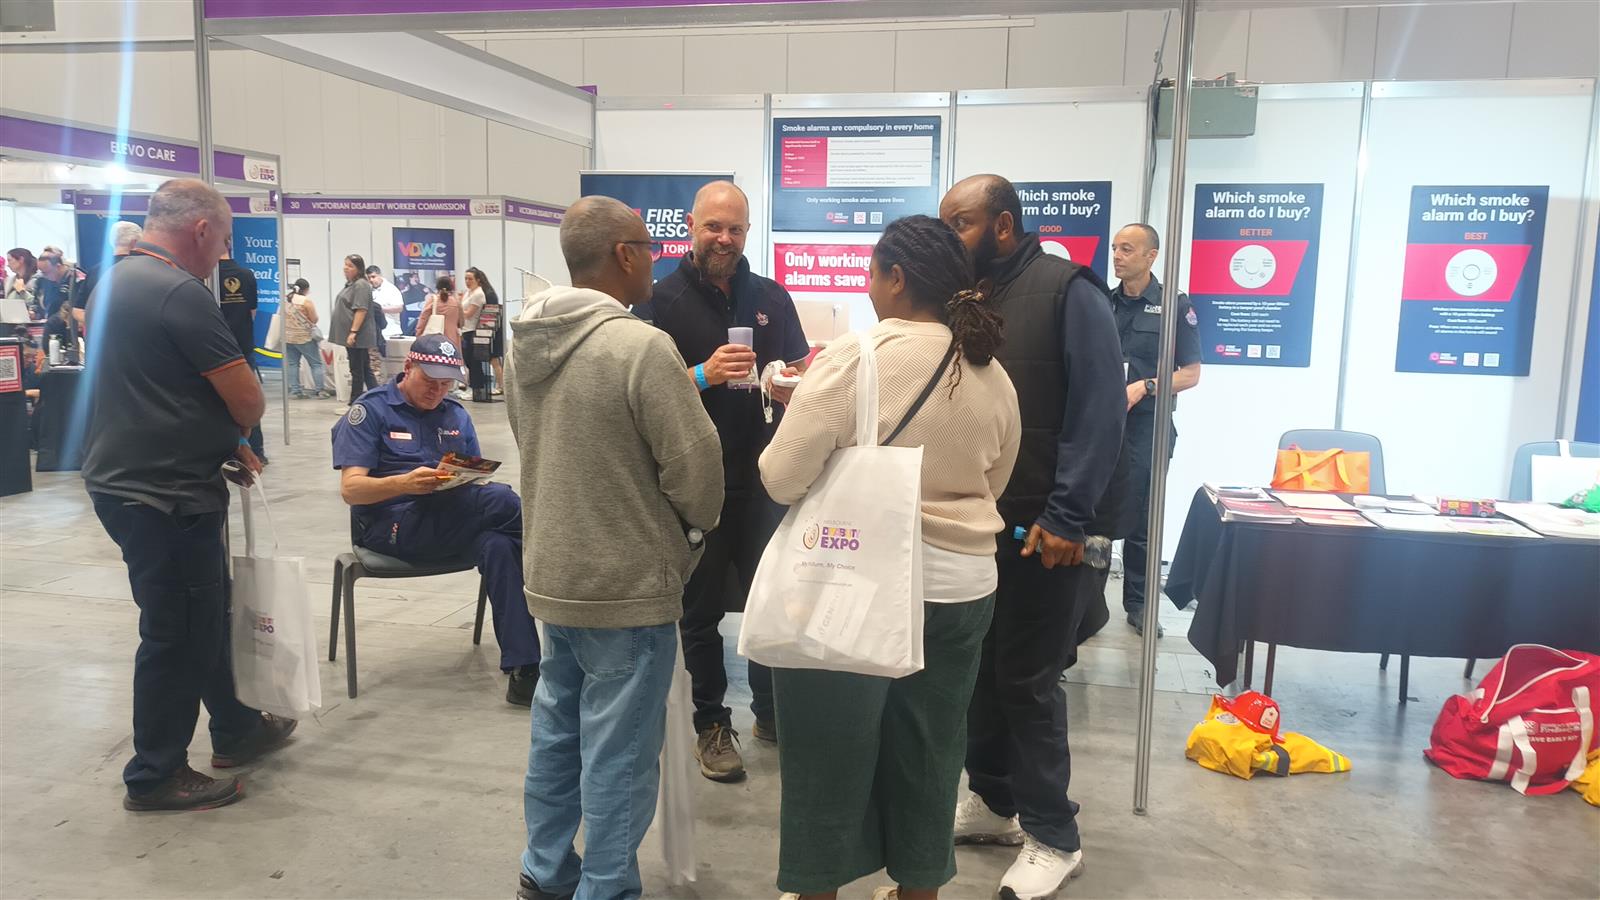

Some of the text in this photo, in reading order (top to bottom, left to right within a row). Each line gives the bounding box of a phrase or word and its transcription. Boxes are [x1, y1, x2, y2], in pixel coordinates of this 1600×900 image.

[844, 123, 883, 132] compulsory
[147, 147, 176, 162] CARE
[1052, 189, 1095, 201] smoke
[1212, 191, 1305, 204] Which smoke
[1430, 193, 1530, 206] Which smoke
[646, 208, 684, 222] FIRE
[1042, 204, 1059, 215] do
[1062, 204, 1066, 215] I
[1070, 204, 1100, 218] buy?
[1205, 206, 1311, 221] alarm do I buy?
[1422, 209, 1535, 224] alarm do I buy?
[646, 224, 688, 237] RESC
[244, 236, 273, 248] Your
[398, 241, 446, 257] VDWC
[245, 252, 276, 263] More
[785, 252, 872, 271] Only working
[785, 271, 866, 287] alarms save
[821, 536, 859, 550] EXPO
